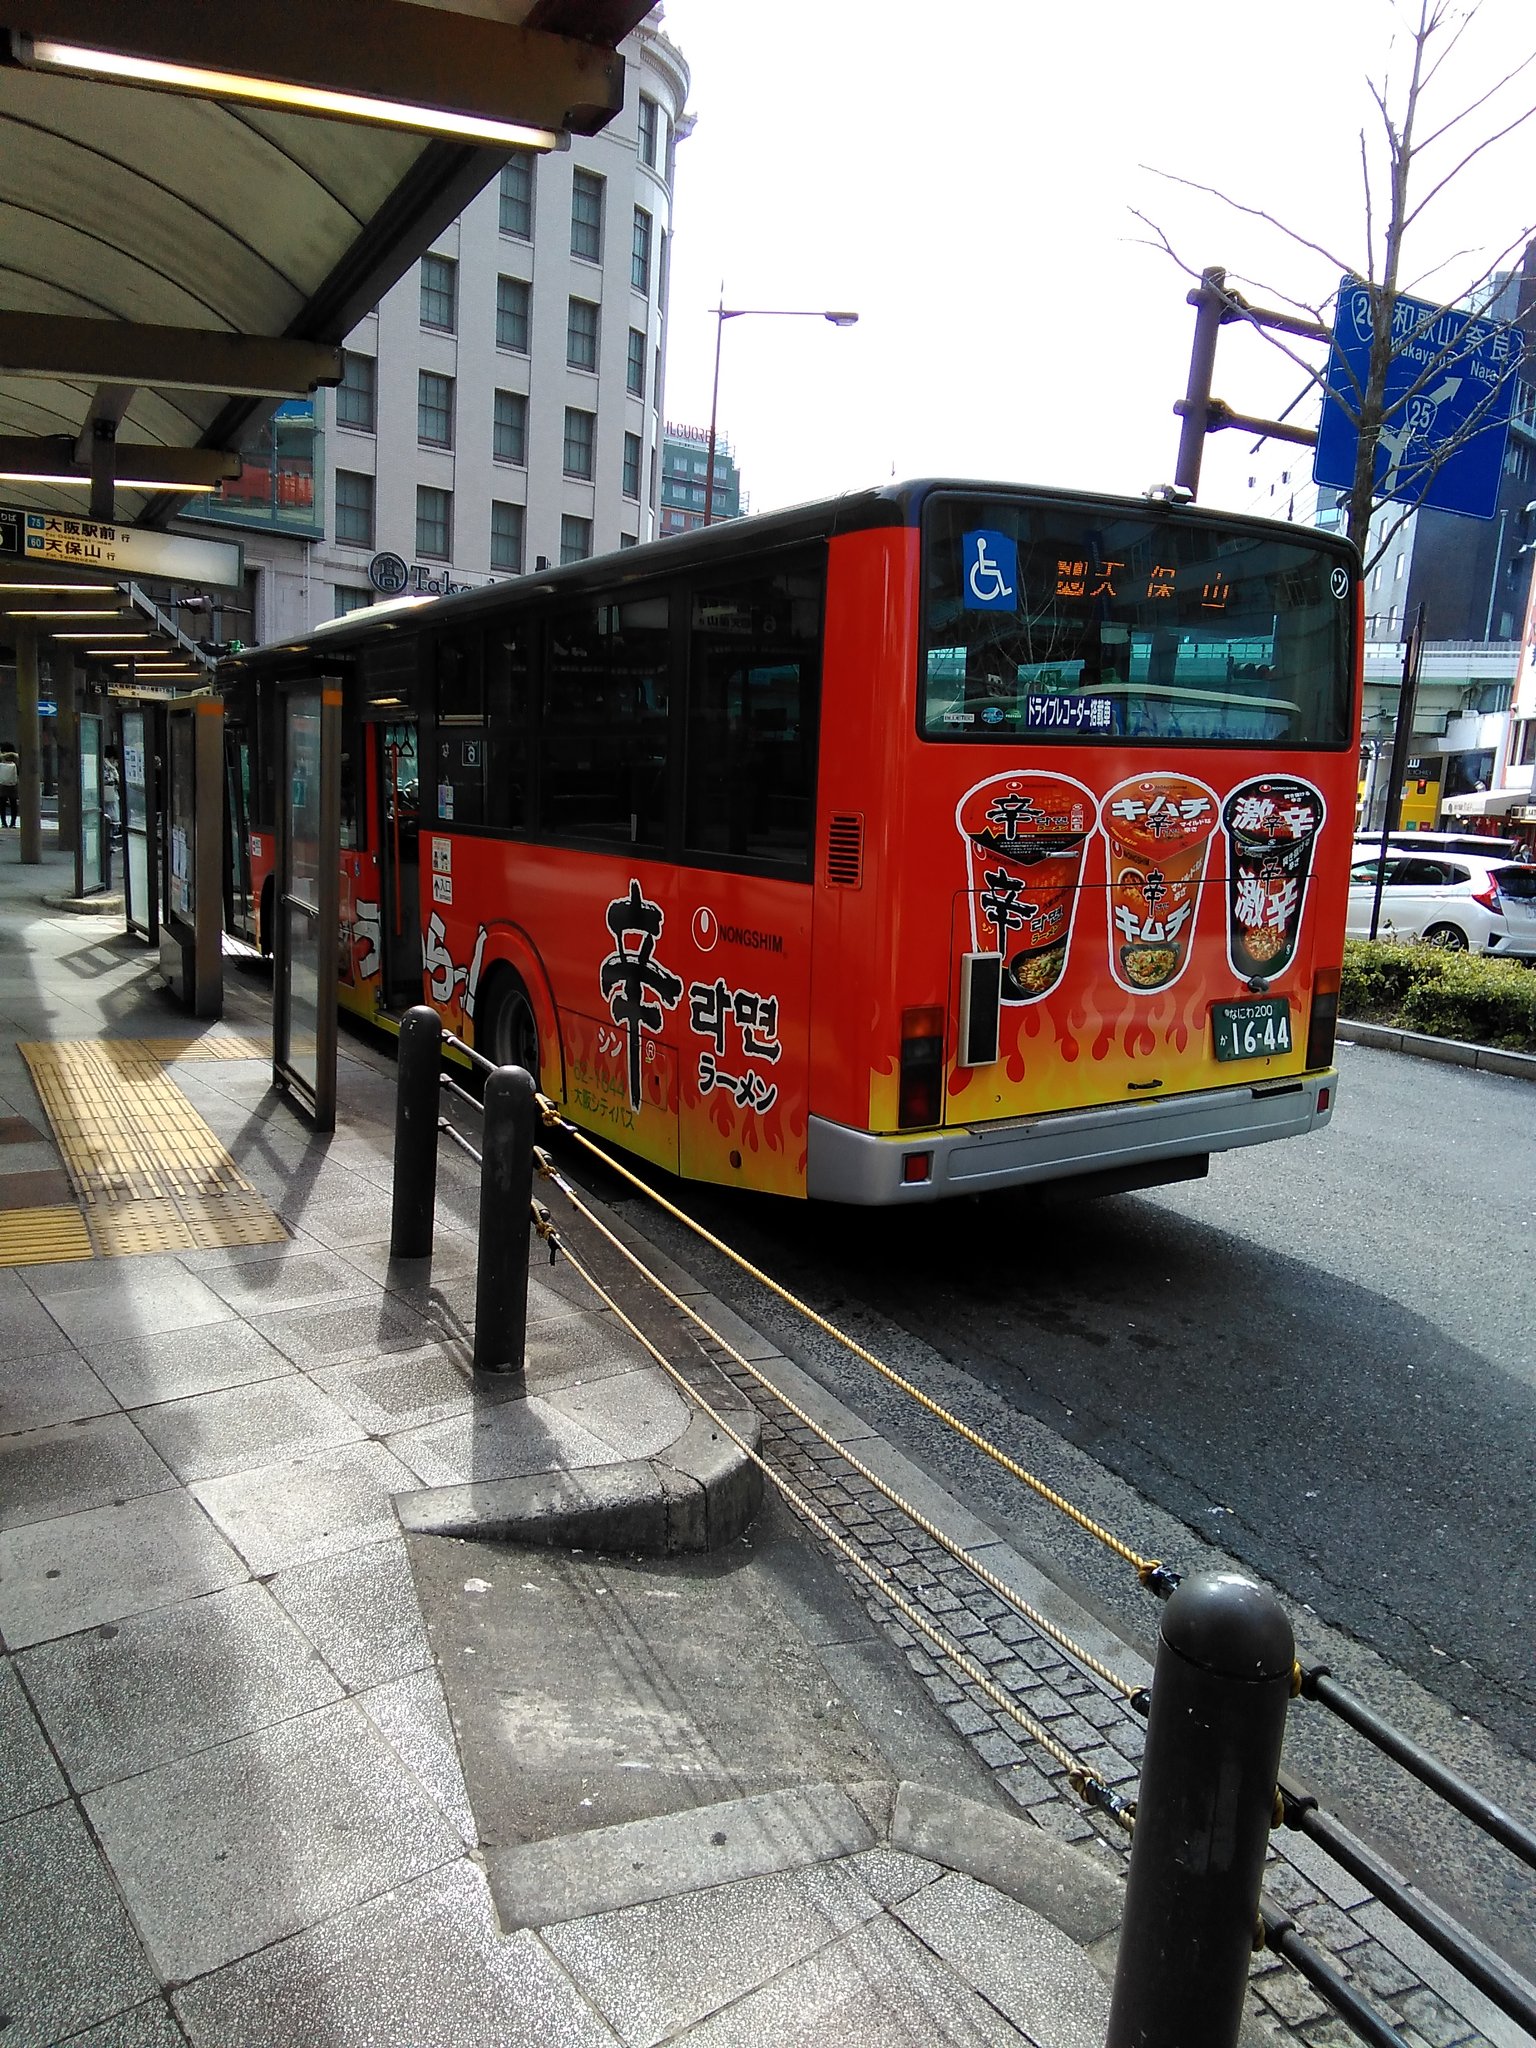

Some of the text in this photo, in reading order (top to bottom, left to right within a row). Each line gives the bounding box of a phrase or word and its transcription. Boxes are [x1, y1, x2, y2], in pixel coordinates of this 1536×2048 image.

[1393, 302, 1508, 361] 和歌山 奈良
[1470, 360, 1497, 382] Nara
[1411, 401, 1430, 428] 25
[31, 517, 131, 543] 75 大阪駅前 行
[31, 538, 116, 561] 60 天保山 行
[985, 793, 1045, 840] 辛
[1111, 796, 1211, 821] キムチ
[1231, 796, 1314, 839] 激辛
[1235, 866, 1298, 933] 激辛
[719, 924, 783, 953] NONGSHIM
[1115, 899, 1192, 943] キムチ
[599, 878, 683, 1115] 辛
[598, 1026, 623, 1057] シン
[688, 978, 782, 1065] 라면
[1232, 1016, 1289, 1055] 16-44
[698, 1052, 778, 1114] ラーメン
